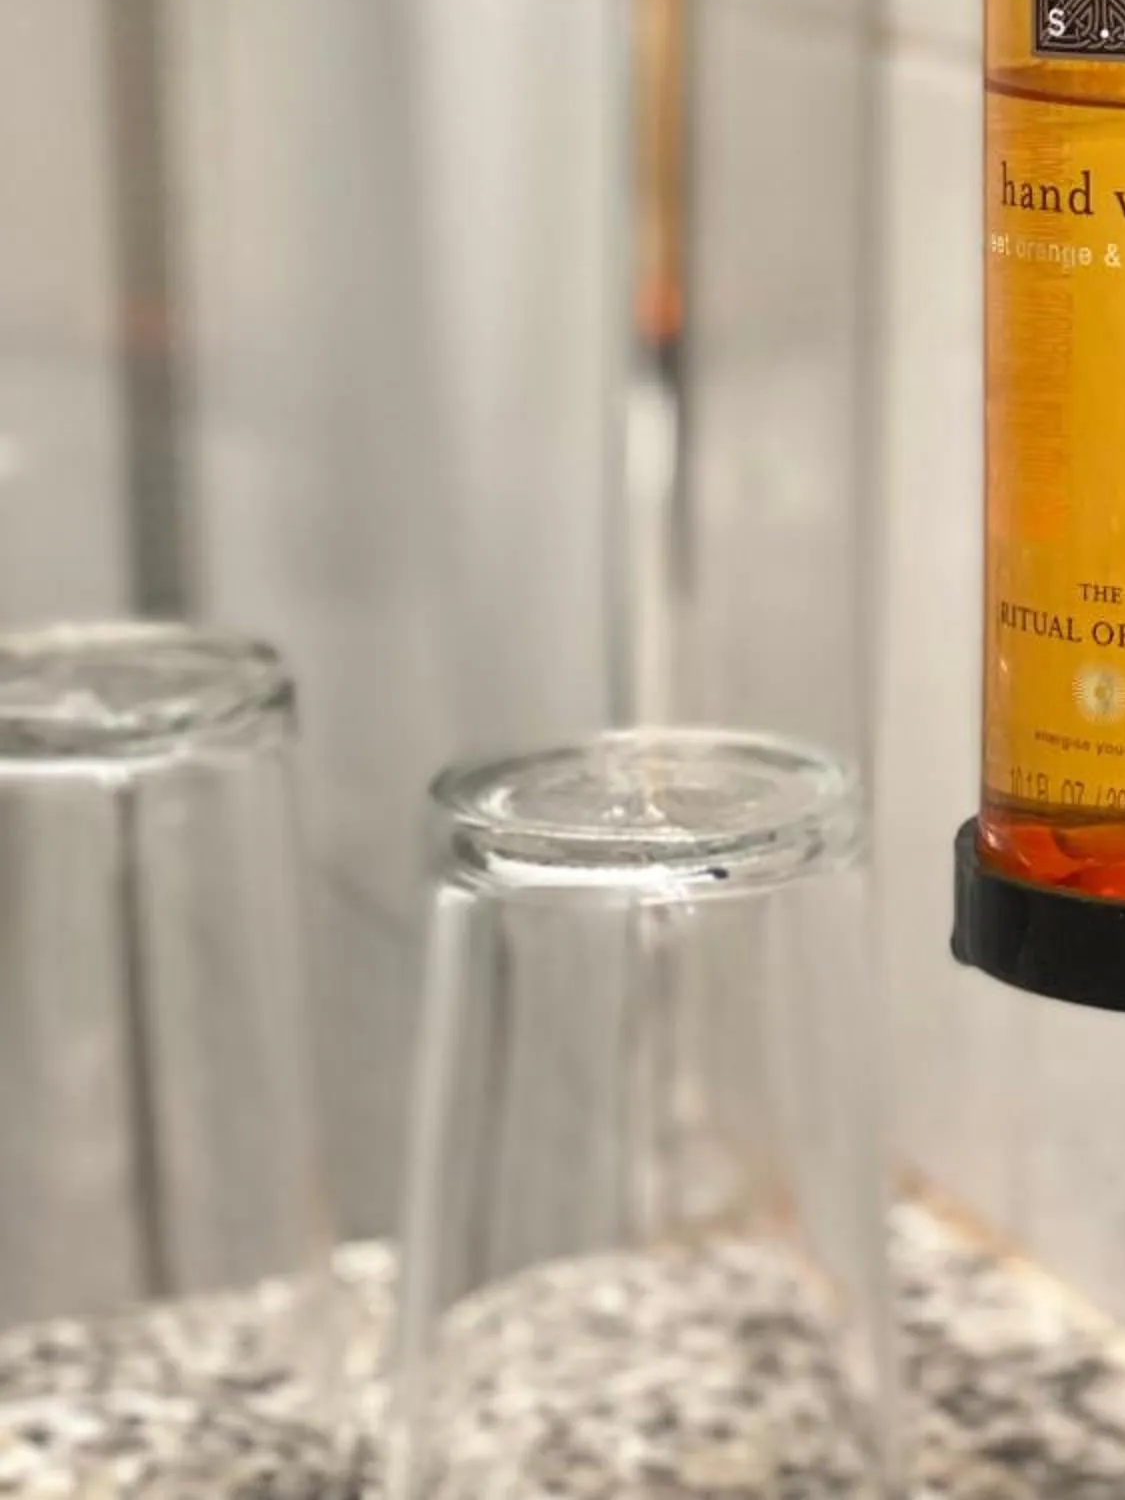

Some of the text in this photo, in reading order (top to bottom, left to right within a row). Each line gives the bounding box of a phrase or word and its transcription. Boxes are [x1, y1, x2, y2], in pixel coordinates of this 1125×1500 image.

[1001, 161, 1095, 216] hand
[1016, 240, 1092, 277] orange
[1104, 243, 1121, 268] &
[1077, 582, 1124, 606] THE
[1000, 600, 1083, 644] RITUAL
